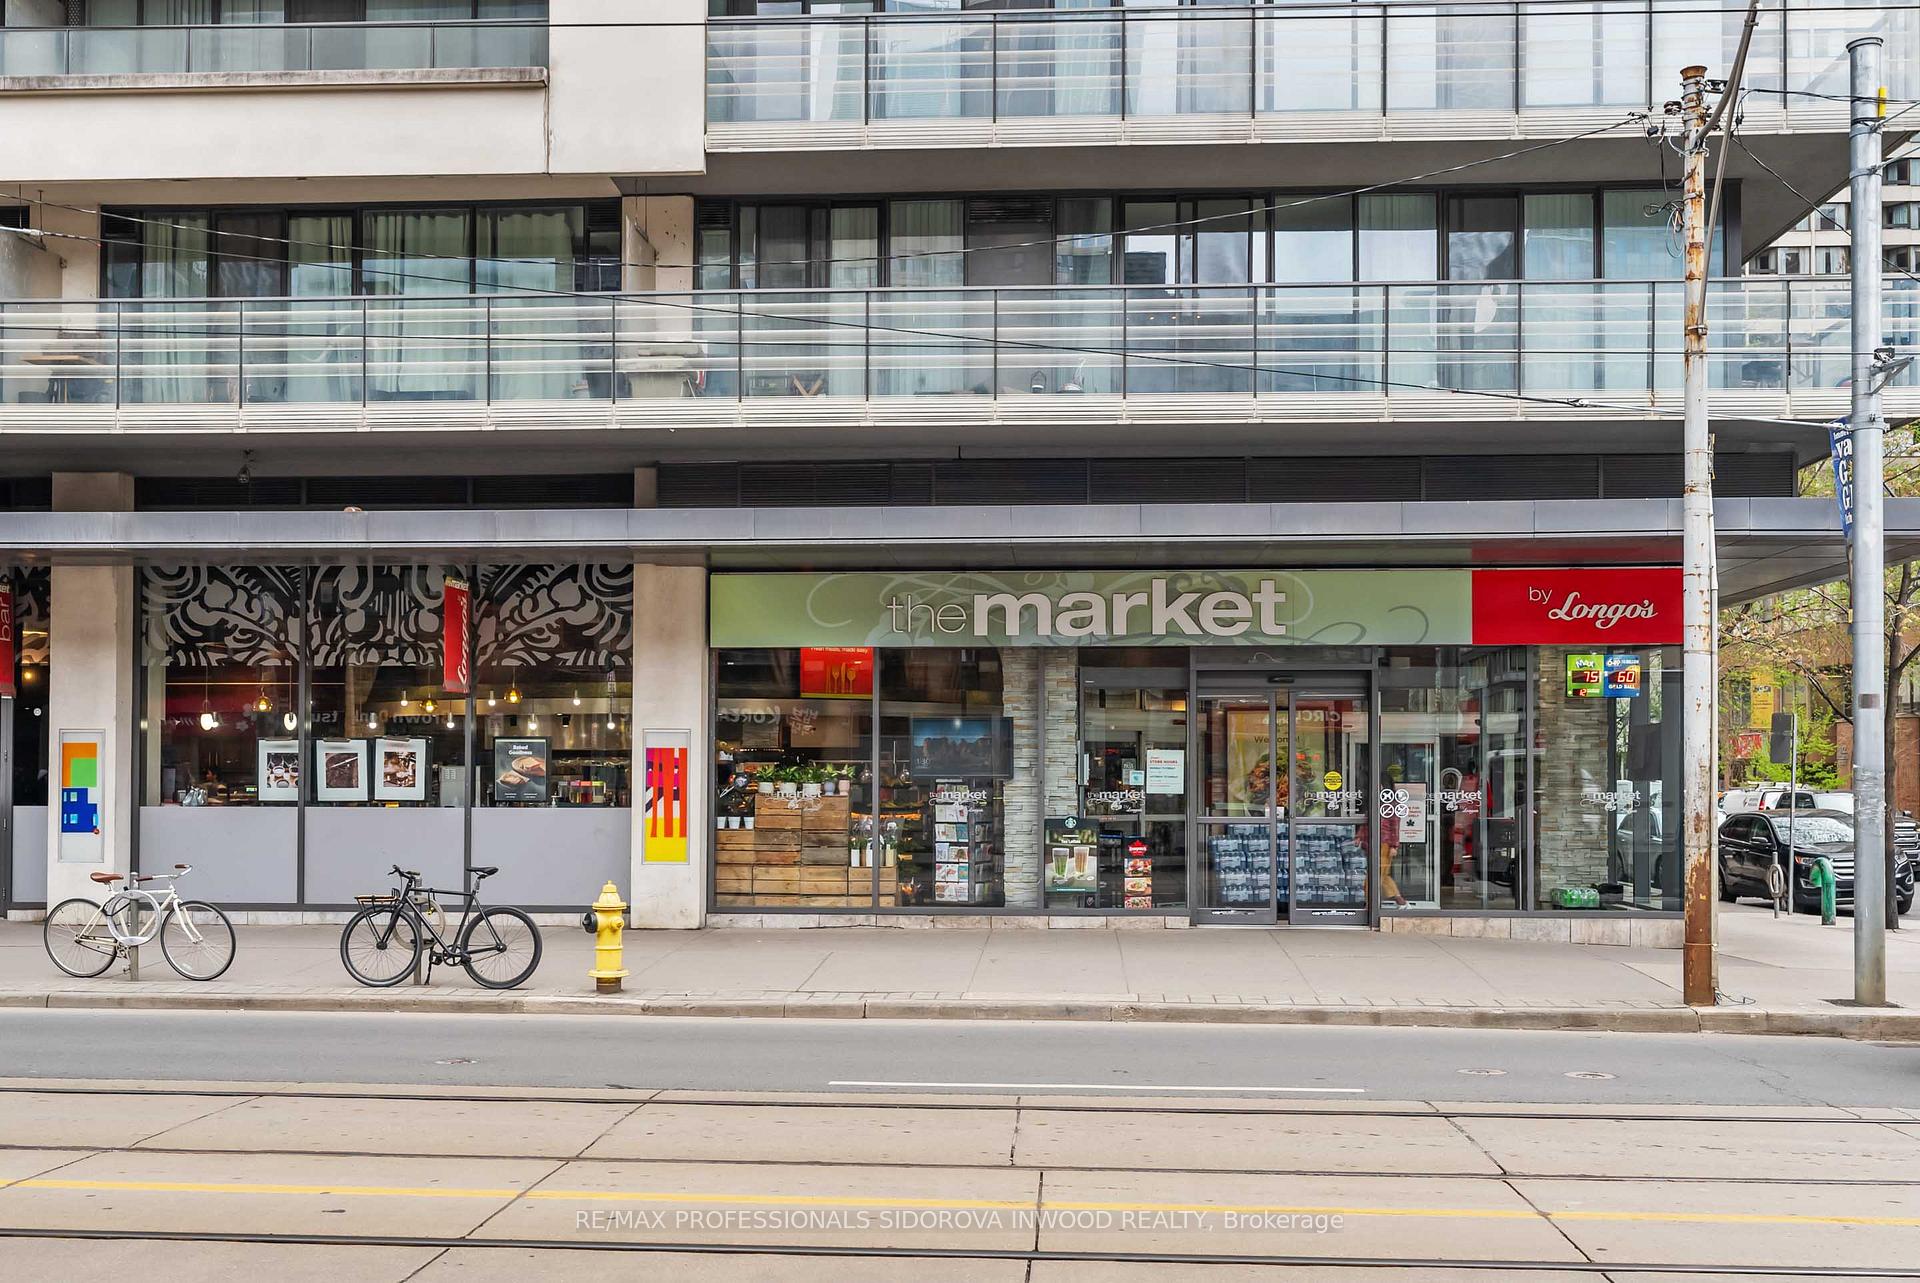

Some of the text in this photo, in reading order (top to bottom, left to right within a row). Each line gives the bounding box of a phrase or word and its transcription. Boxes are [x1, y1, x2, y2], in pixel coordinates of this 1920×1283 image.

[886, 577, 1287, 638] the market
[1528, 586, 1659, 630] by Longo's
[1583, 671, 1599, 683] 75
[1617, 671, 1635, 683] 60
[941, 789, 987, 800] market
[1099, 789, 1146, 799] market
[1316, 789, 1363, 799] market
[1440, 790, 1482, 800] market
